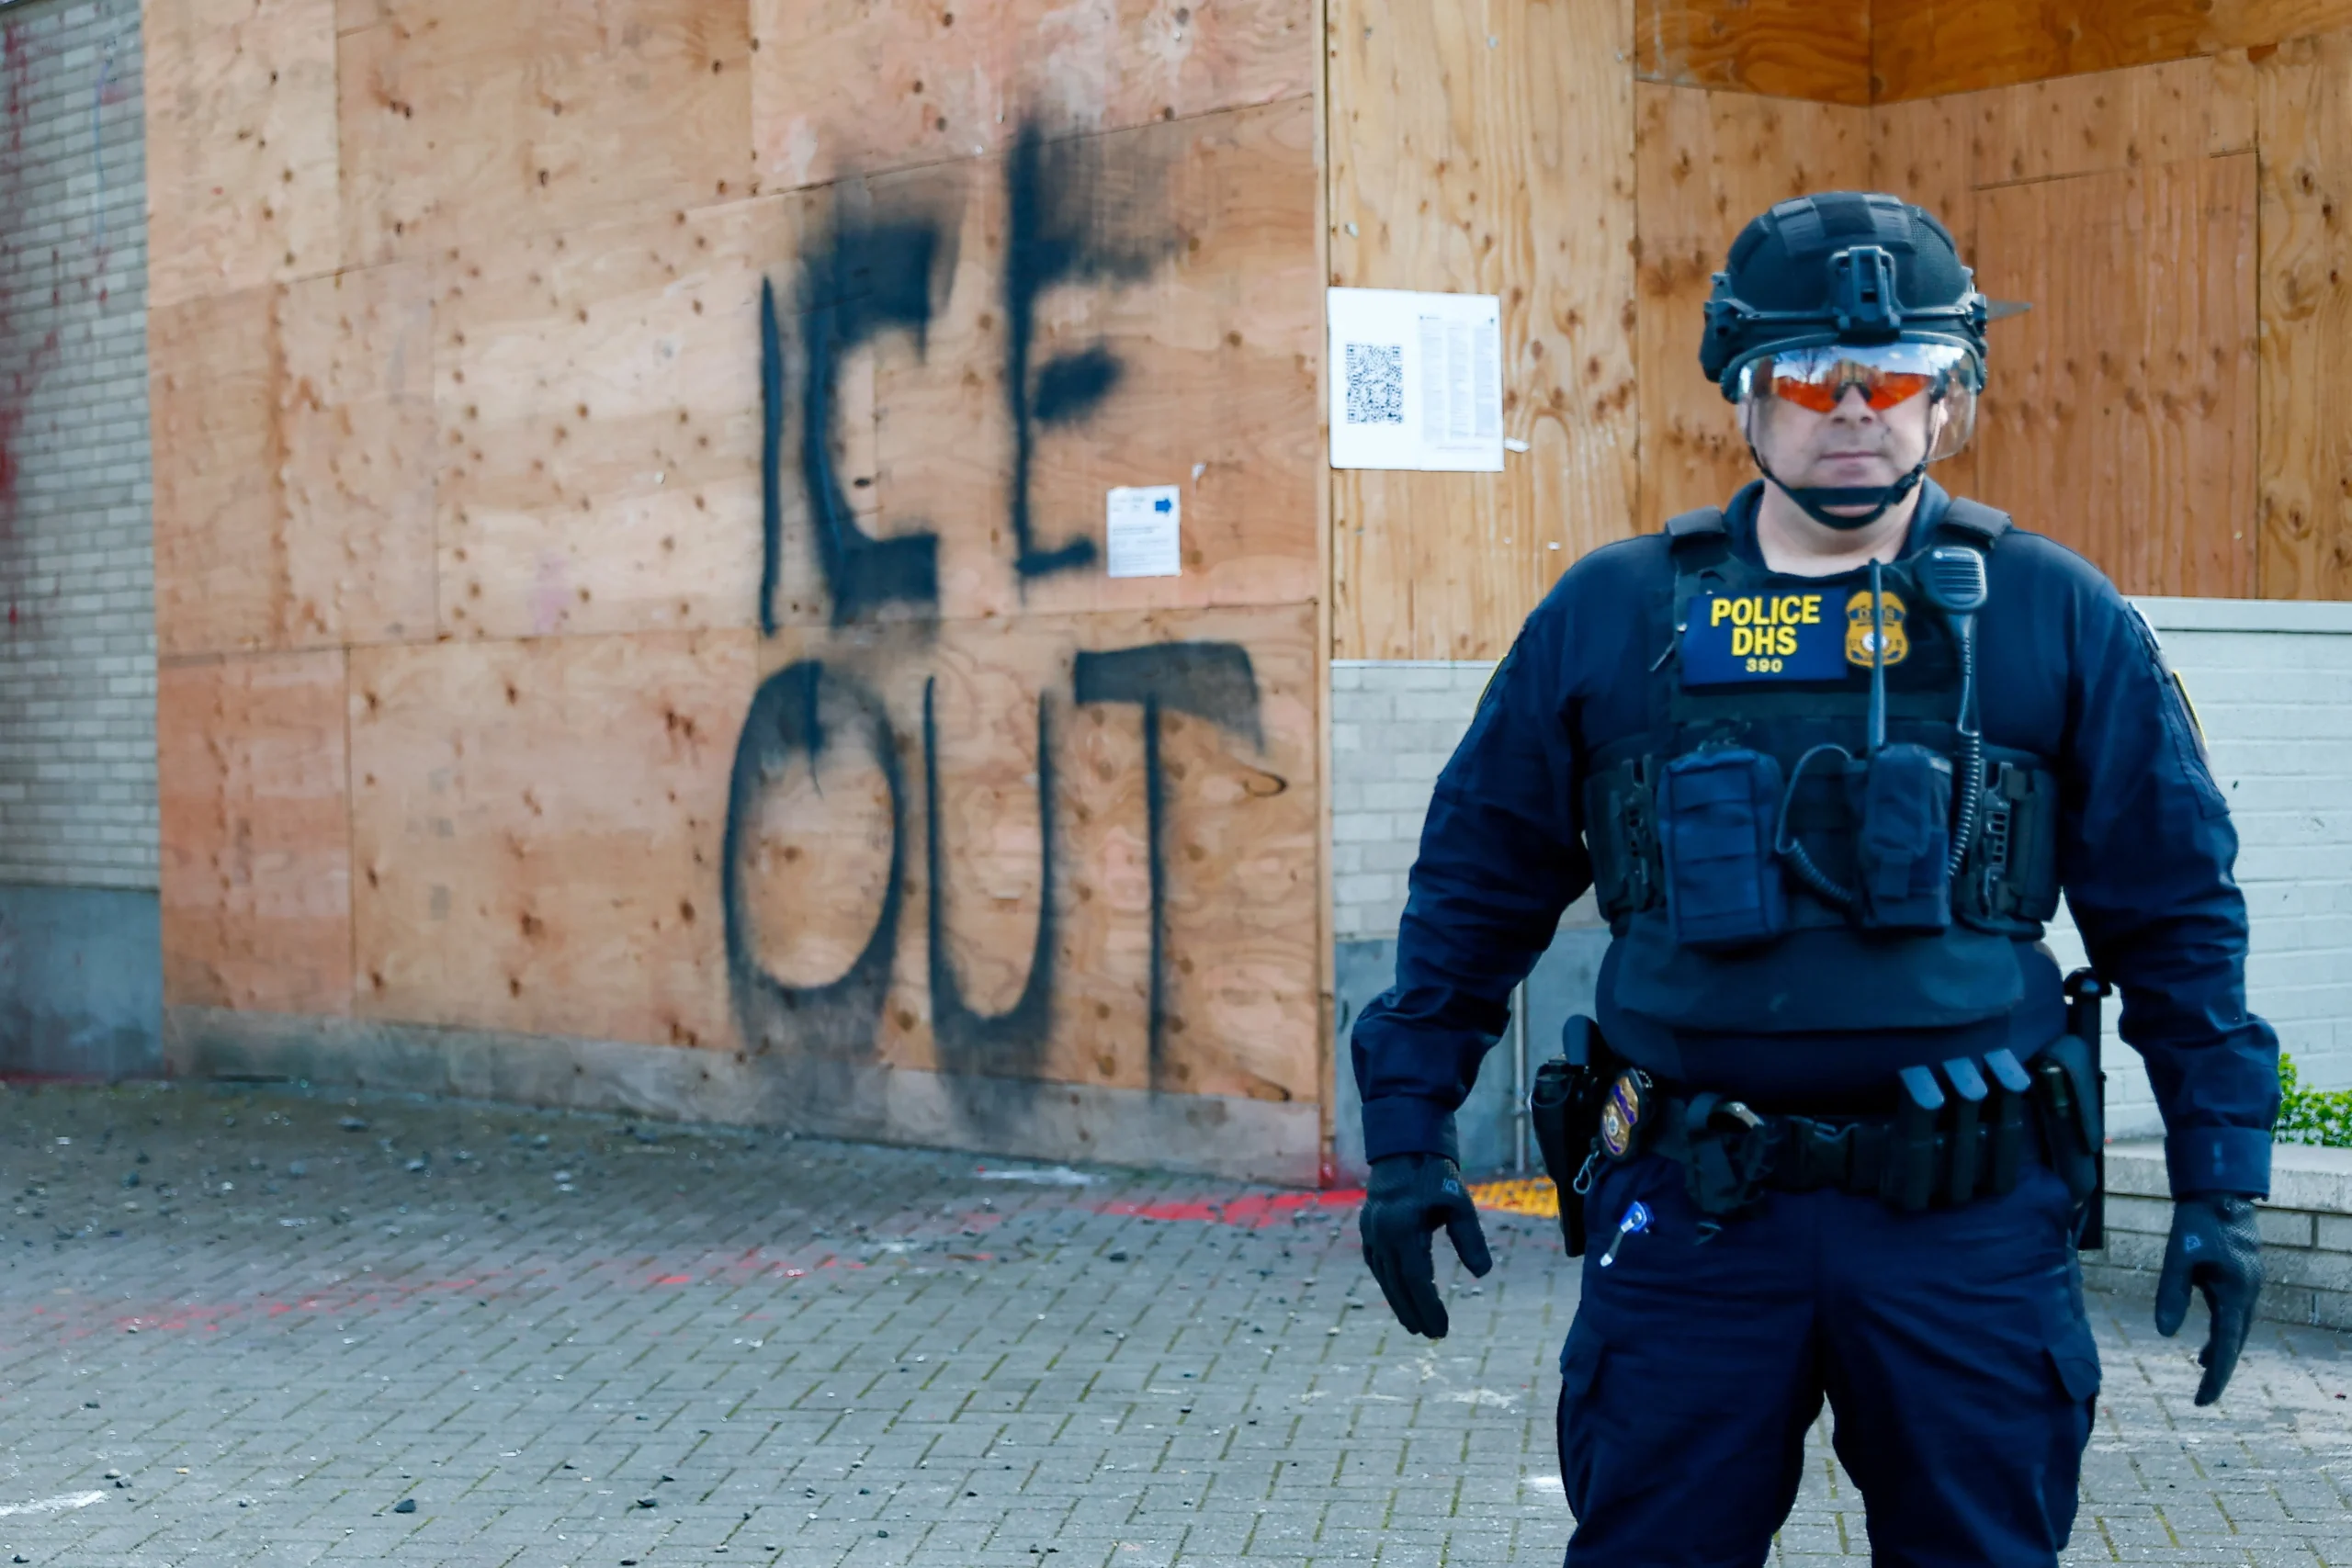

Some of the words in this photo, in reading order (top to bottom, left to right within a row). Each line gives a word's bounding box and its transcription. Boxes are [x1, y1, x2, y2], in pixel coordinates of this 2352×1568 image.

[759, 118, 1159, 637] ICE
[1710, 595, 1822, 627] POLICE
[1731, 626, 1798, 656] DHS
[1745, 658, 1783, 672] 390
[723, 640, 1267, 1107] OUT
